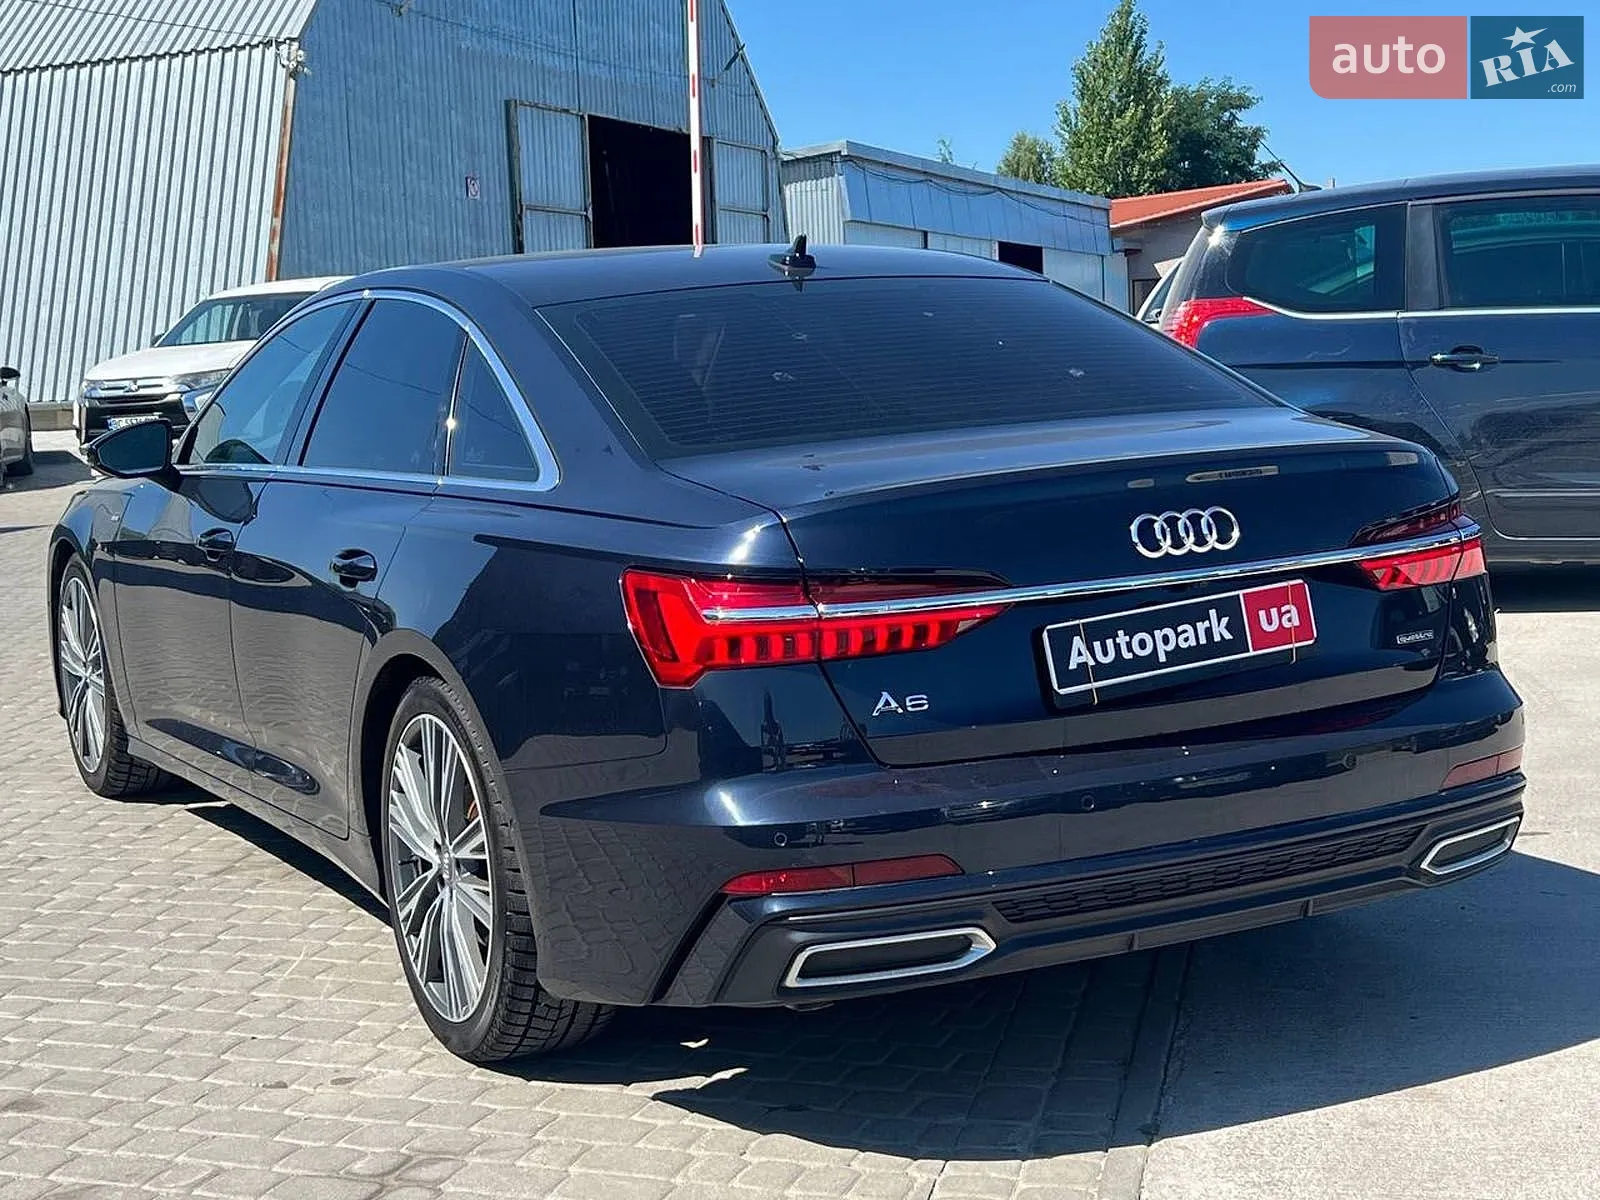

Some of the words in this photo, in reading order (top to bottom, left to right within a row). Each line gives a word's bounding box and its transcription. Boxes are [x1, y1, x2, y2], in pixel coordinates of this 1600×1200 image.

[1068, 608, 1233, 670] Autopark
[1258, 603, 1300, 633] ua
[872, 691, 929, 716] A6
